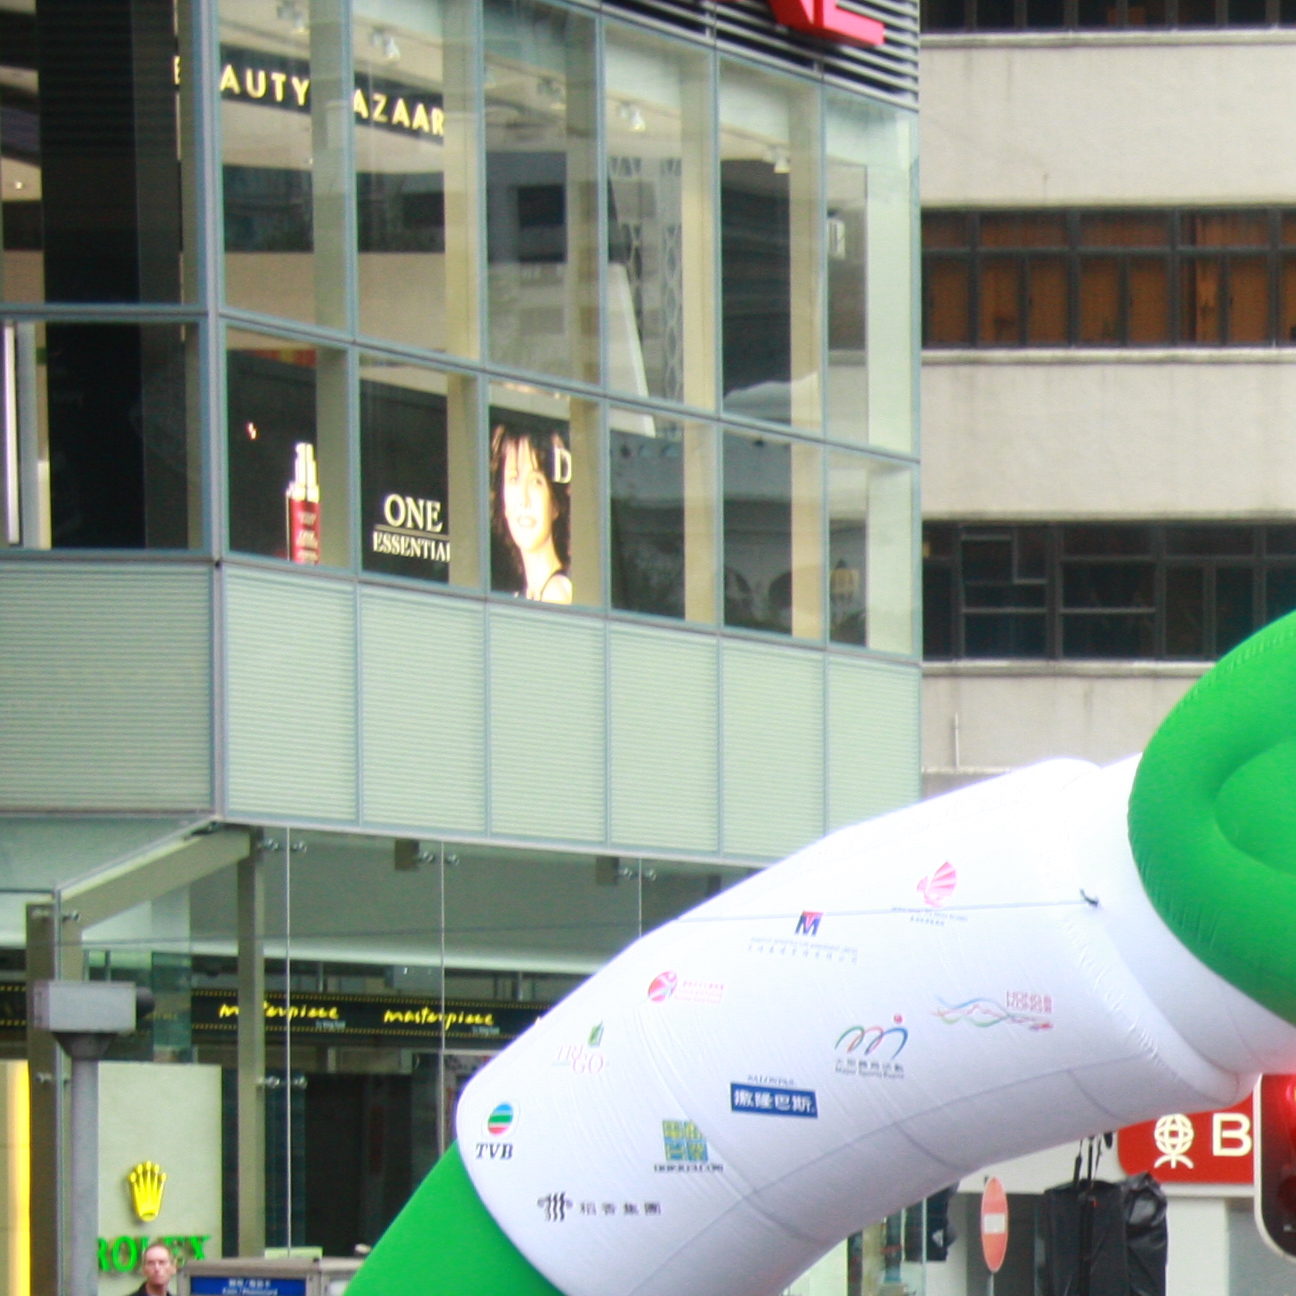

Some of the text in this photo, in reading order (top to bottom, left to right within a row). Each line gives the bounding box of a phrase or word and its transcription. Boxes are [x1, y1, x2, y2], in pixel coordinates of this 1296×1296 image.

[353, 87, 444, 137] AZAAR
[383, 493, 444, 532] ONE
[475, 1142, 514, 1160] TVB
